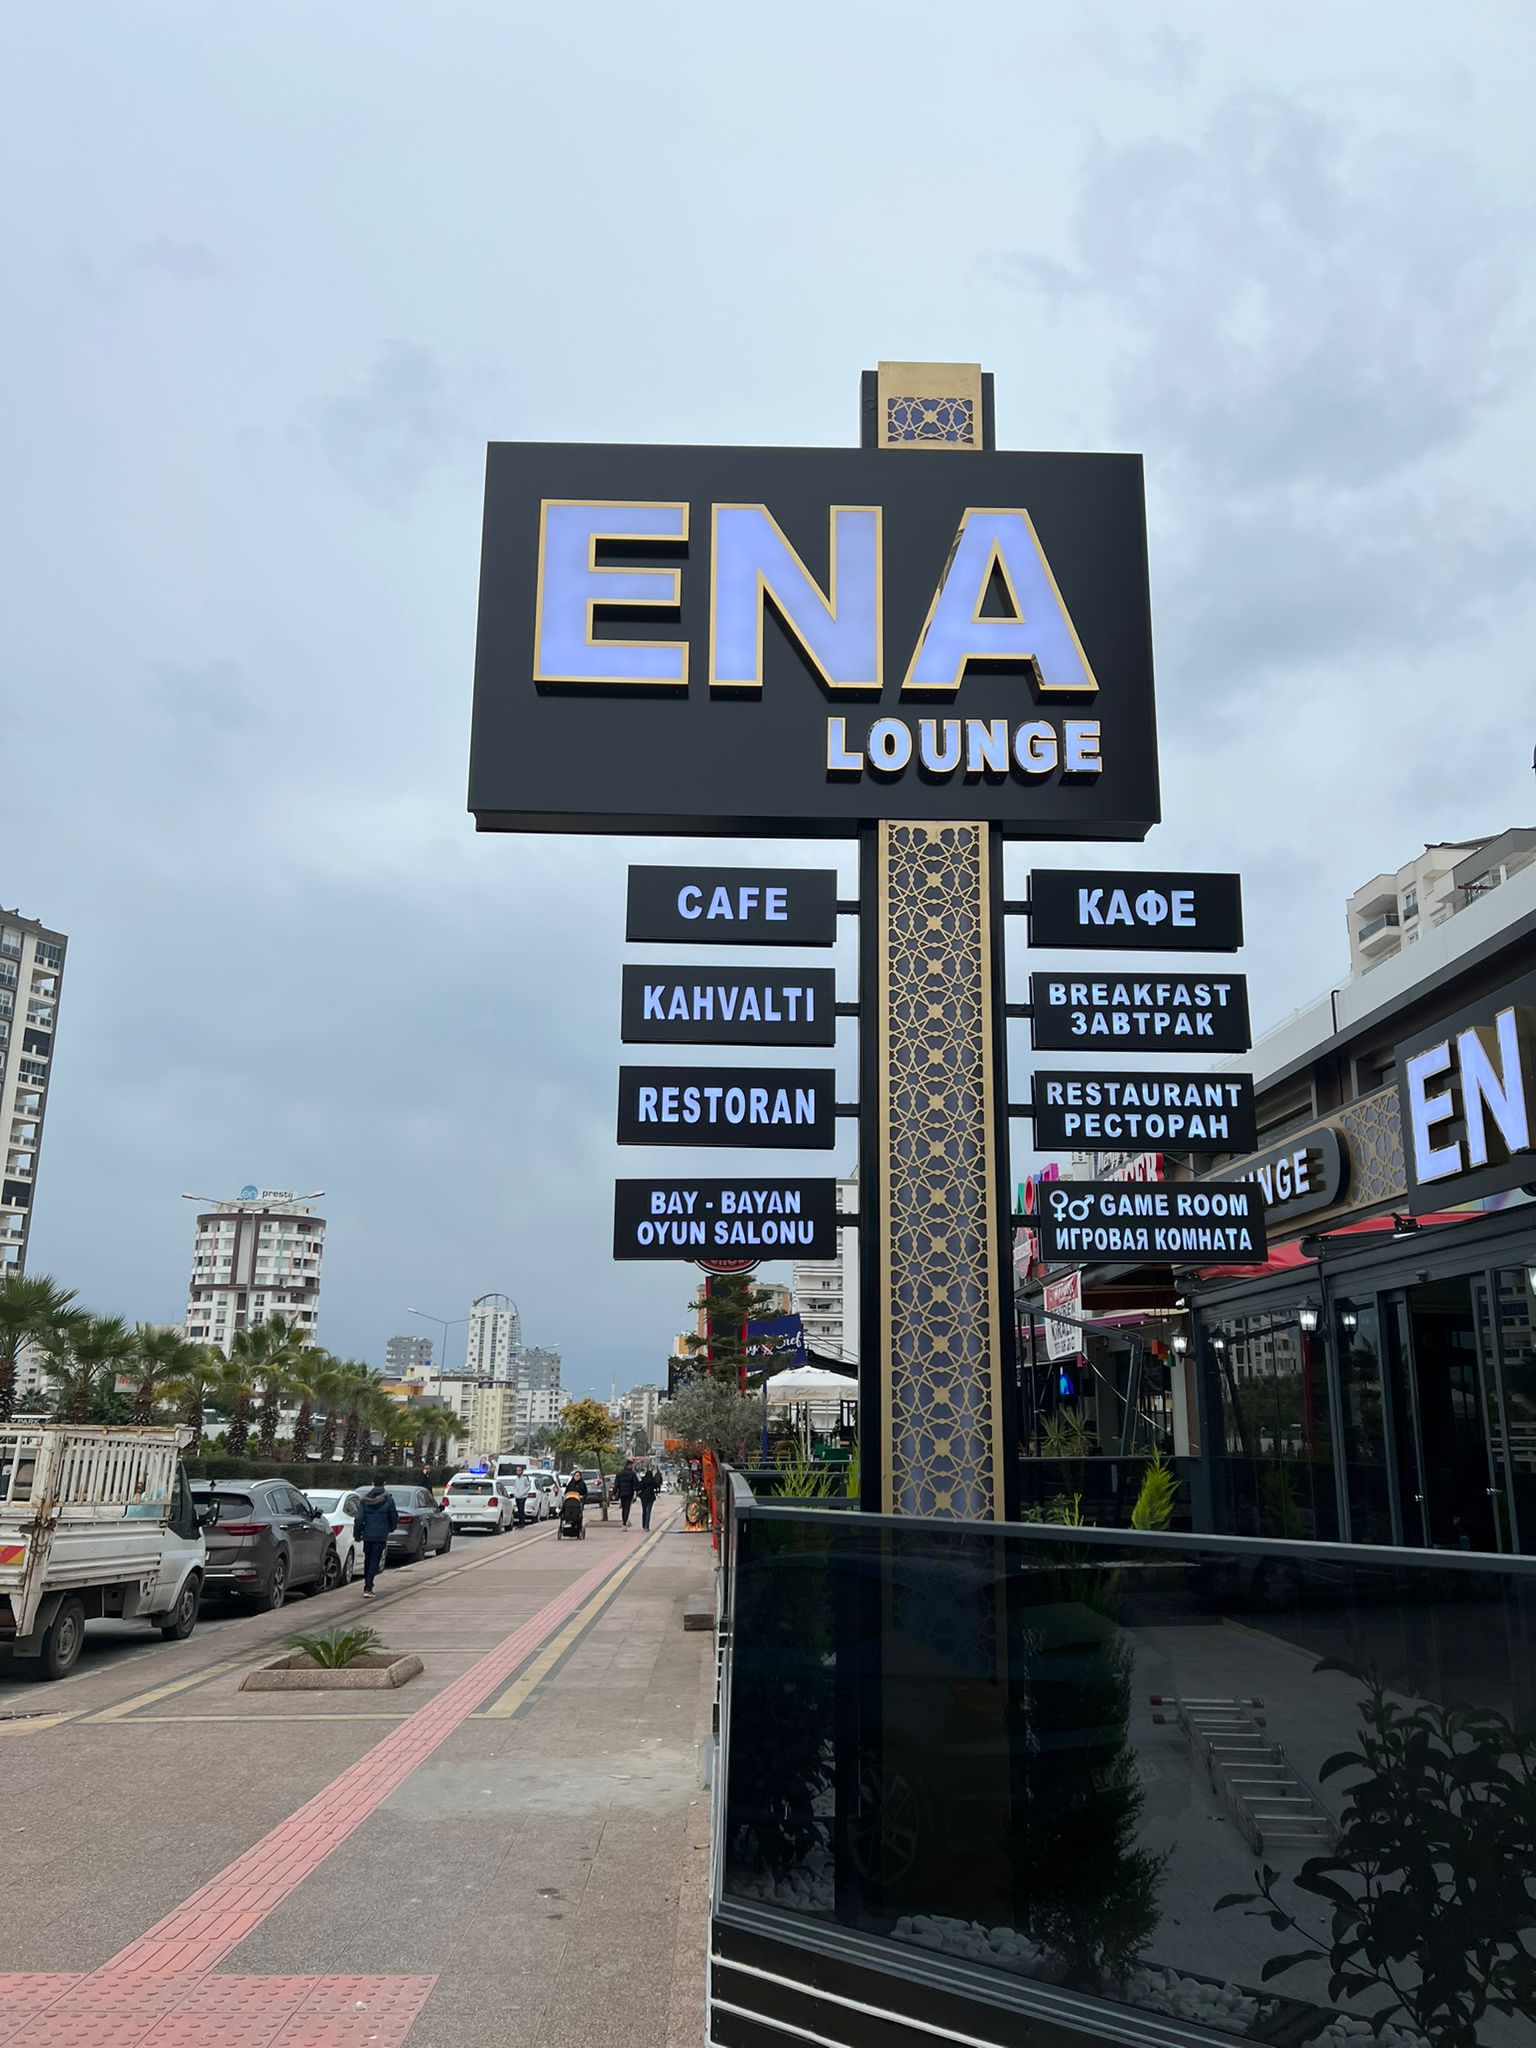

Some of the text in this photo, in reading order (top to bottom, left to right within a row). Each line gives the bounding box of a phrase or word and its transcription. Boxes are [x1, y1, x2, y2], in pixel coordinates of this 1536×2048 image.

[532, 498, 1100, 693] ENA
[826, 716, 1104, 774] LOUNGE
[676, 884, 789, 922] CAFE
[1077, 887, 1198, 928] КАФЕ
[642, 983, 816, 1023] KAHVALTI
[1047, 982, 1232, 1008] BREAKFAST
[1070, 1010, 1215, 1037] ЗАВТРАК
[637, 1085, 817, 1126] RESTORAN
[1045, 1081, 1243, 1108] RESTAURANT
[1063, 1111, 1230, 1140] РЕСТОРАН
[649, 1190, 699, 1216] BAY
[720, 1189, 802, 1216] BAYAN
[1098, 1192, 1250, 1218] GAME ROOM
[635, 1219, 815, 1247] OYUN SALONU
[1054, 1226, 1254, 1252] ИГРОВАЯ КОМНАТА
